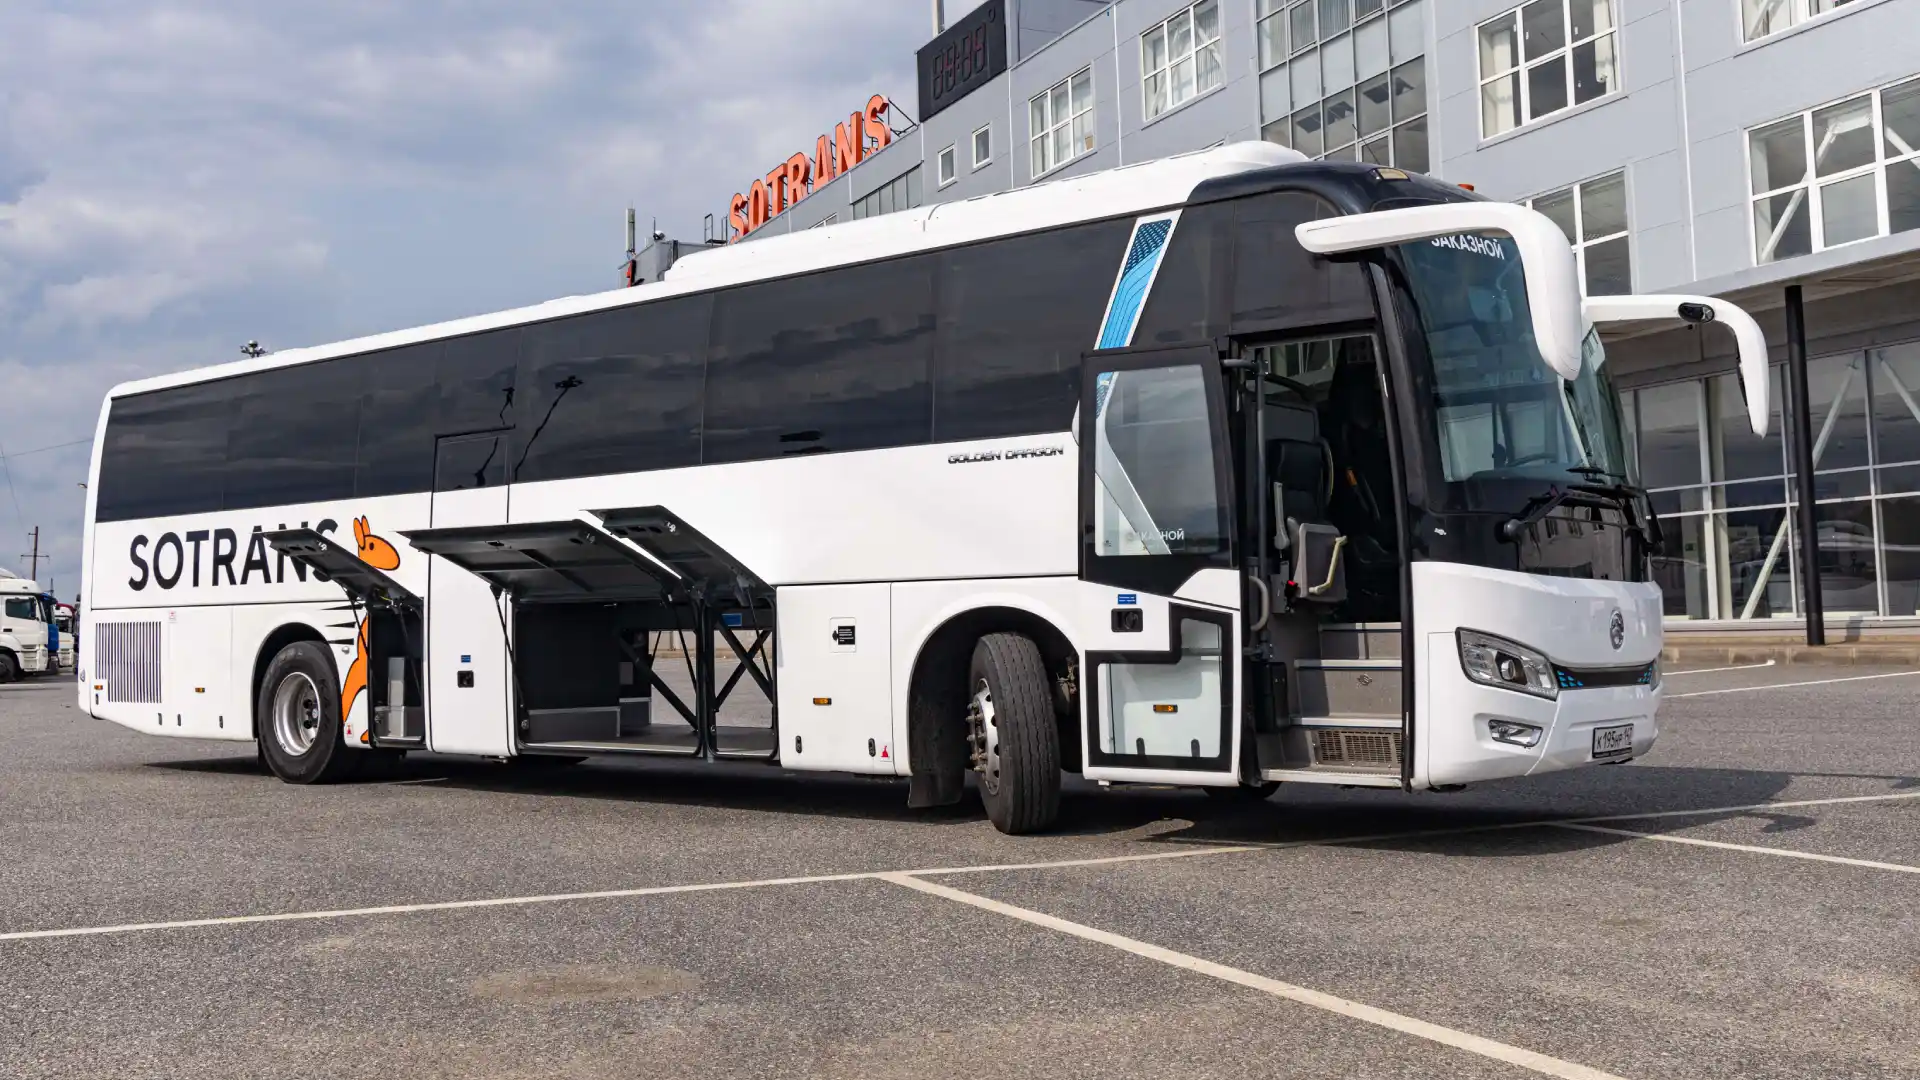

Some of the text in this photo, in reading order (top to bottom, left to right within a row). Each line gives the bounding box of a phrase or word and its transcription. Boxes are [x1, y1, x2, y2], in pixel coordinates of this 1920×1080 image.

[729, 94, 891, 245] SOTRANS
[948, 446, 1064, 464] GOLDEN DRAGON
